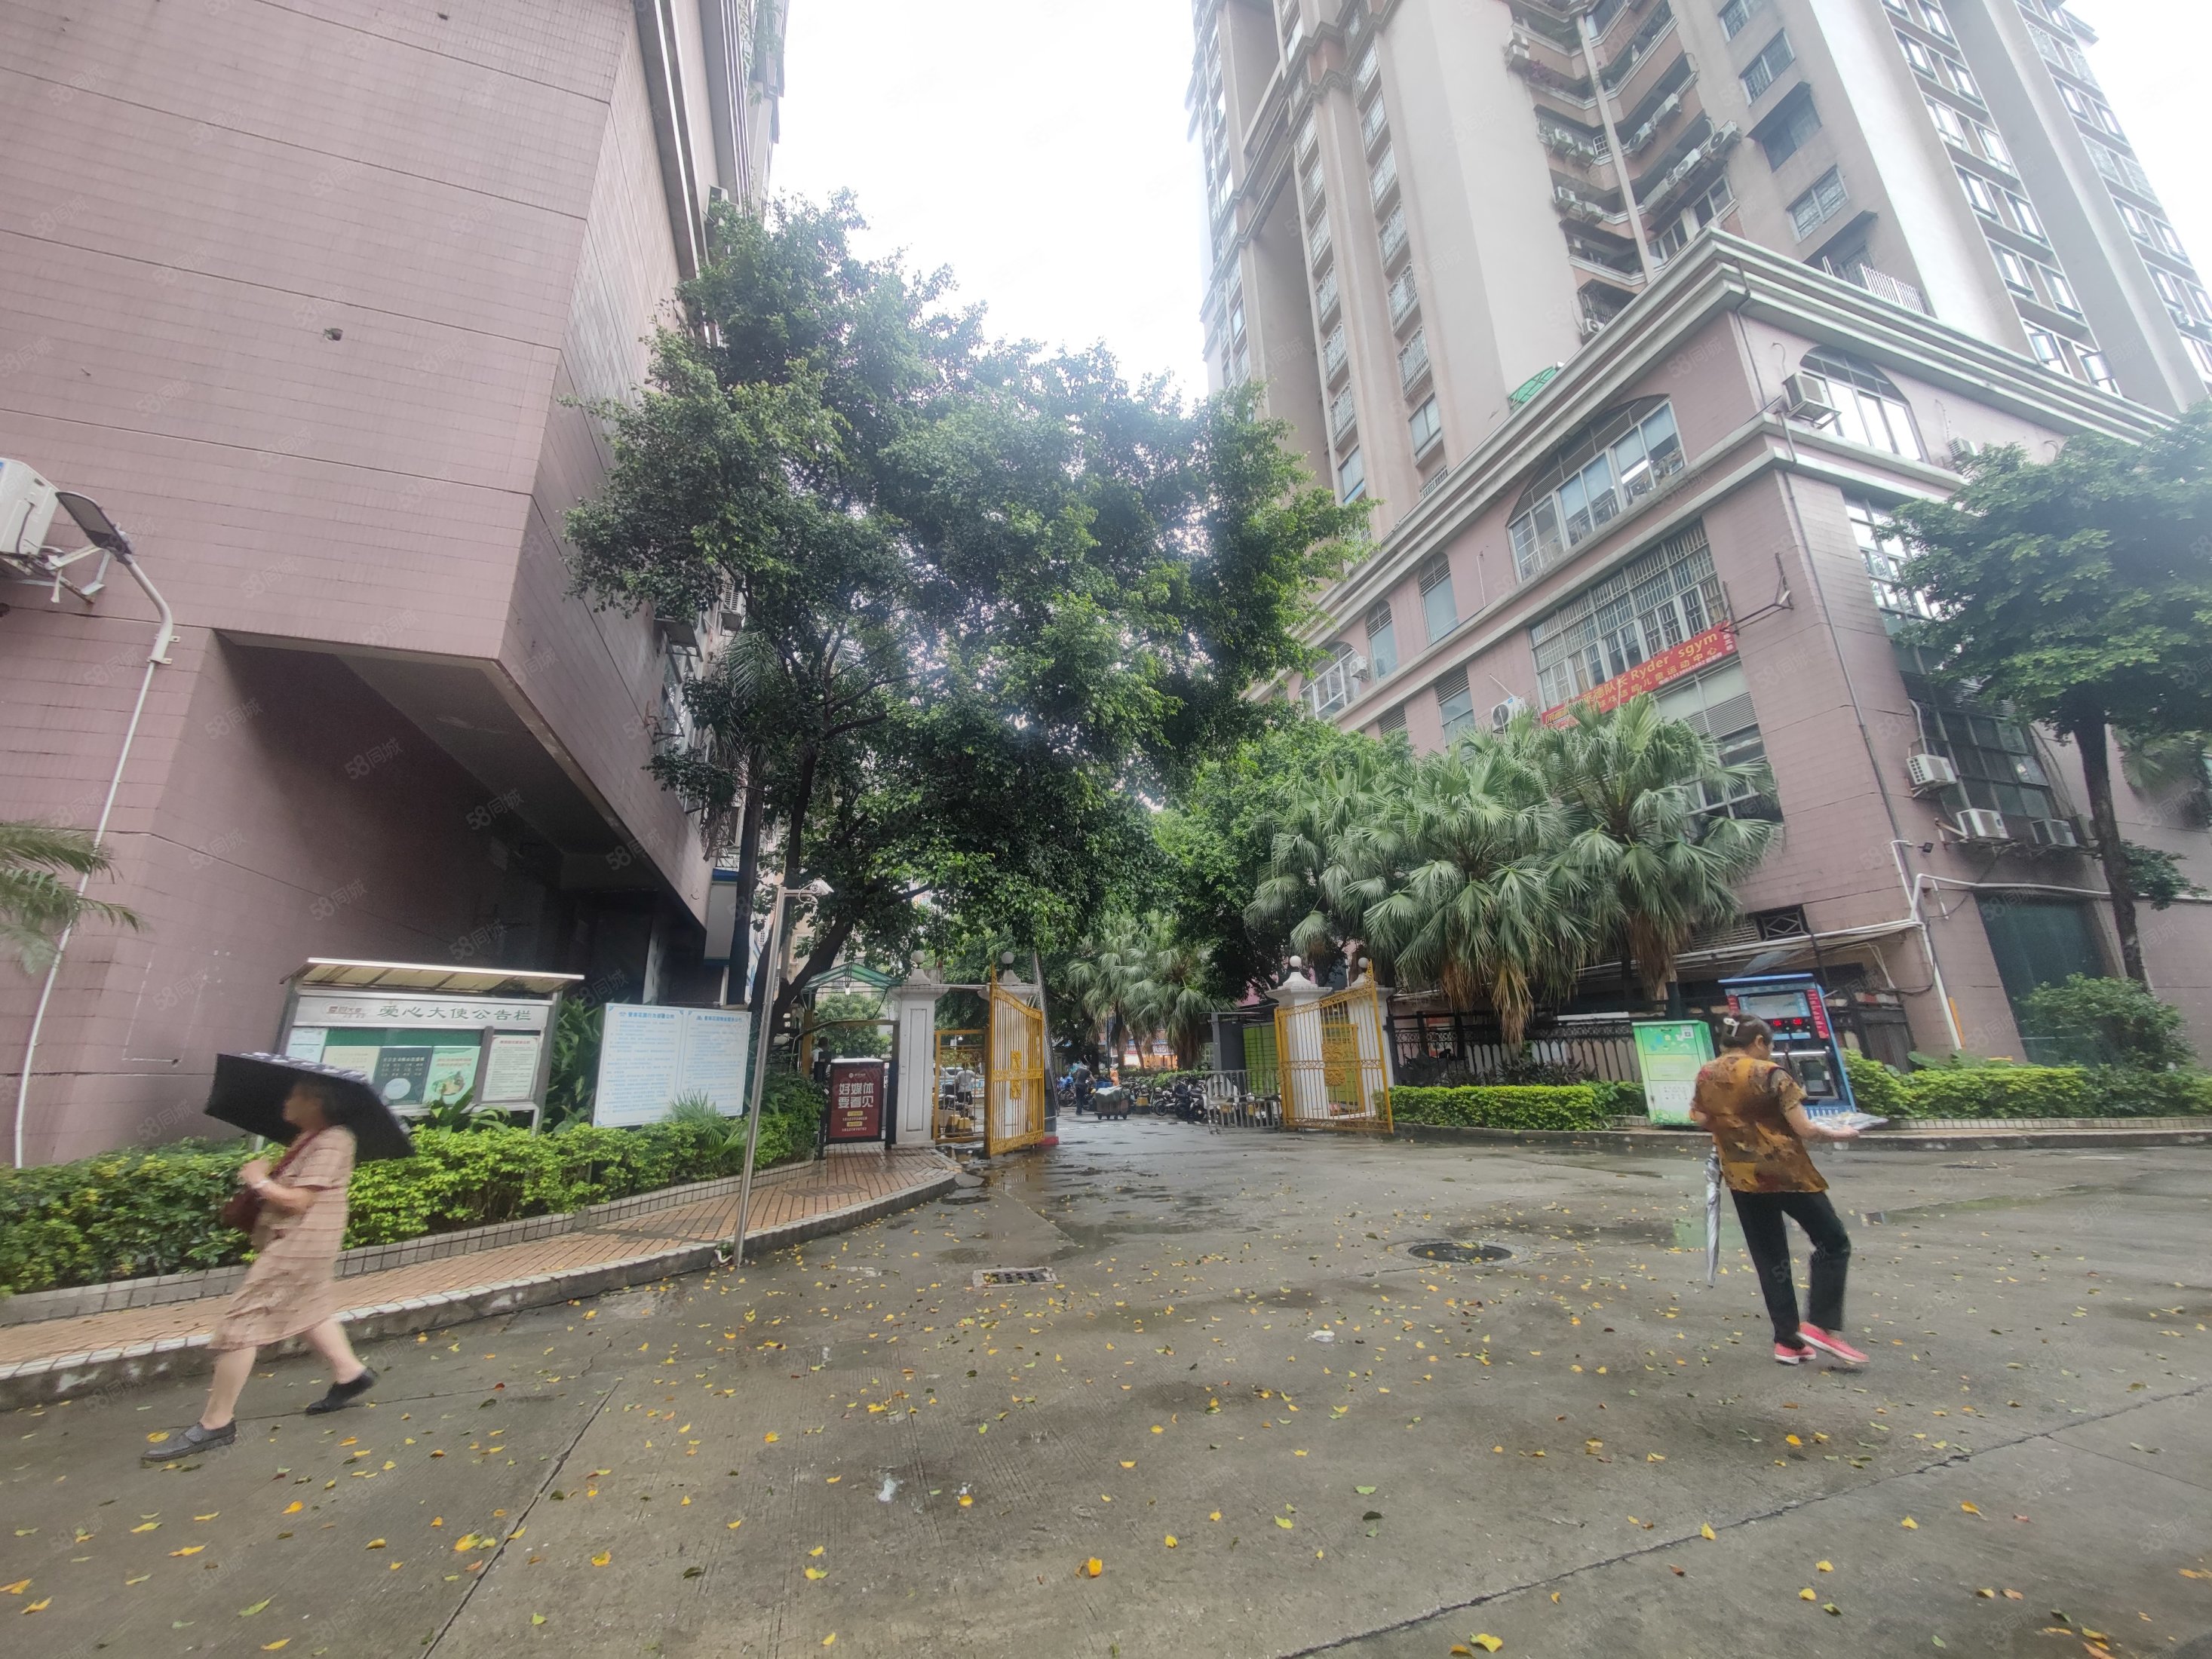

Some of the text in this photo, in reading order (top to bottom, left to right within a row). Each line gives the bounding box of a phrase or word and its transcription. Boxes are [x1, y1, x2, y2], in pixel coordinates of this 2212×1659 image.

[376, 1004, 532, 1021] 爱心大使公告栏
[839, 1082, 874, 1095] 好媒体
[838, 1096, 873, 1109] 要看见
